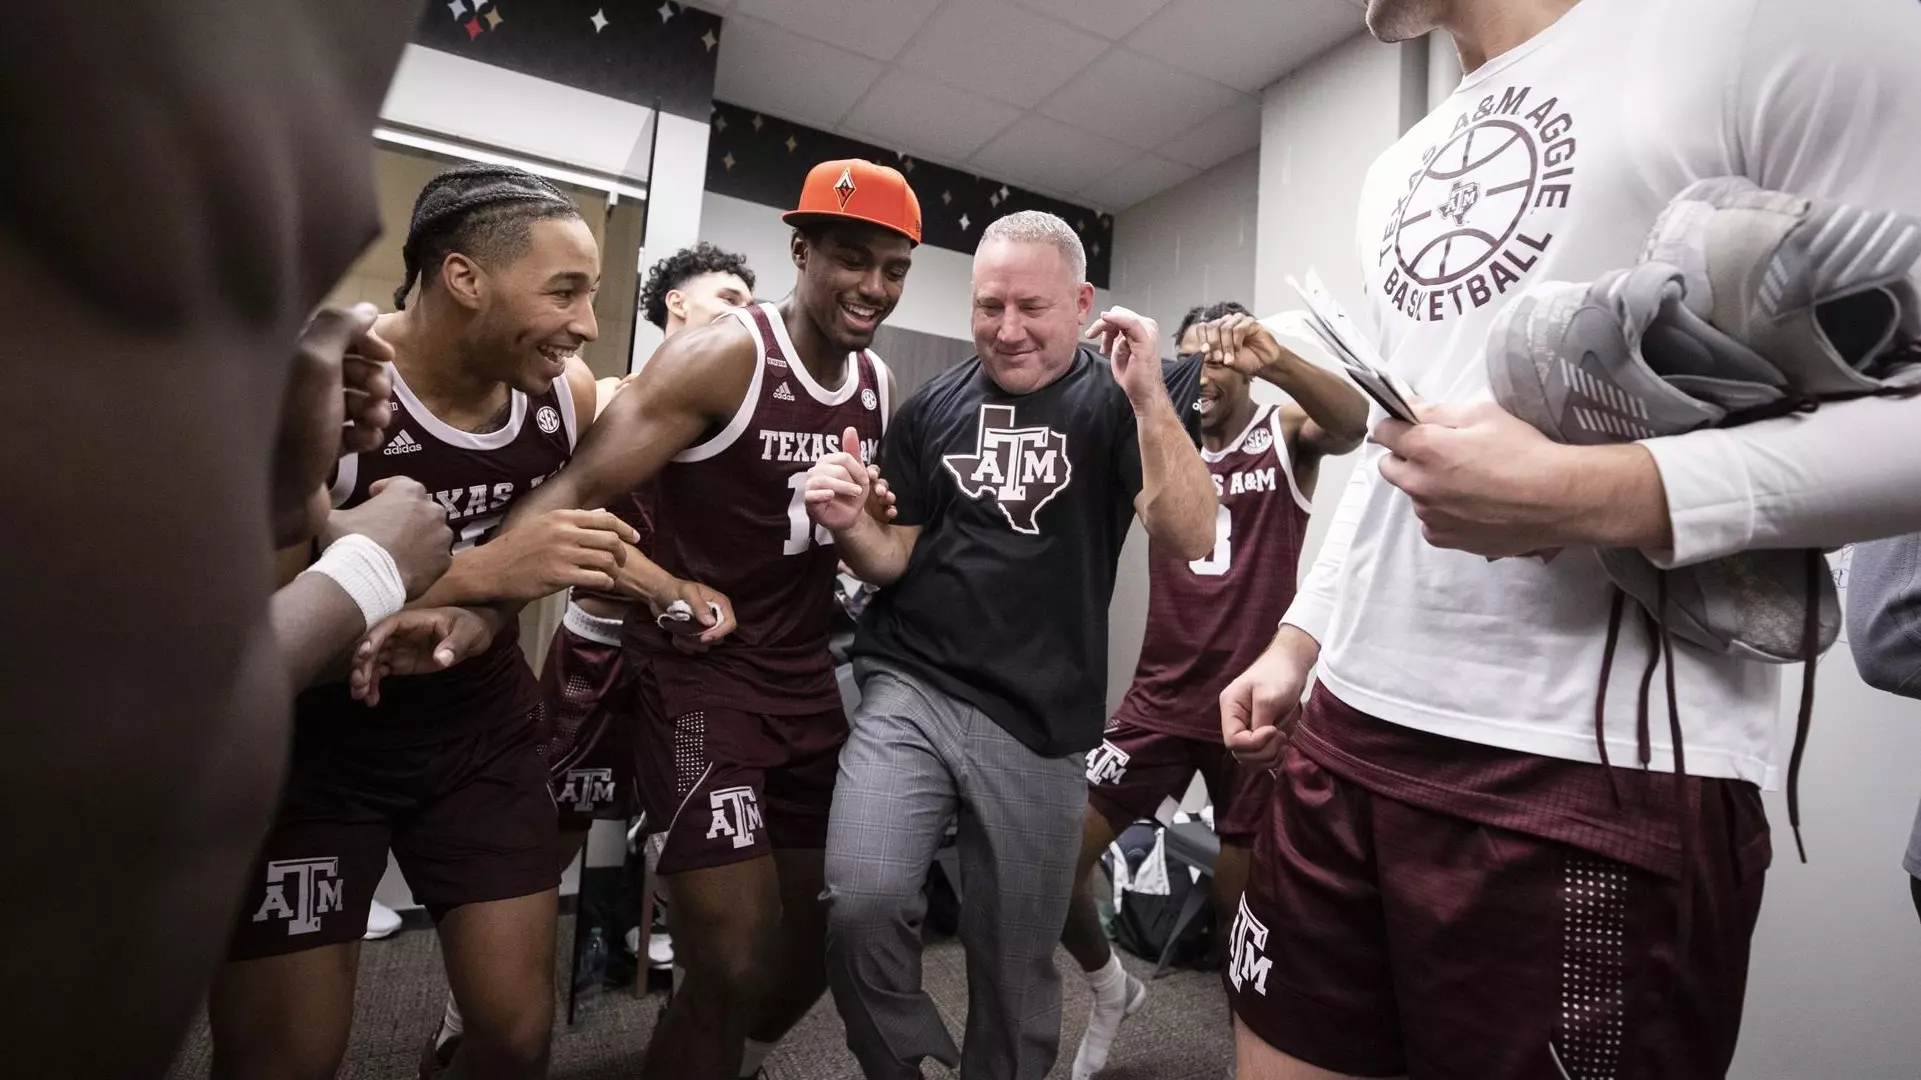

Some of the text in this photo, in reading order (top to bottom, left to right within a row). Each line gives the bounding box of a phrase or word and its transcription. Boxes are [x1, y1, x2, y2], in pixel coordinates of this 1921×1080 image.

[1449, 86, 1532, 140] A&M
[1524, 96, 1576, 208] AGGIE
[1383, 232, 1553, 321] BASKETBALL
[773, 391, 795, 401] adidas
[538, 408, 558, 431] SEC
[383, 443, 423, 455] adidas
[759, 429, 839, 462] TEXAS
[1230, 467, 1276, 495] A&M
[426, 482, 514, 519] XAS
